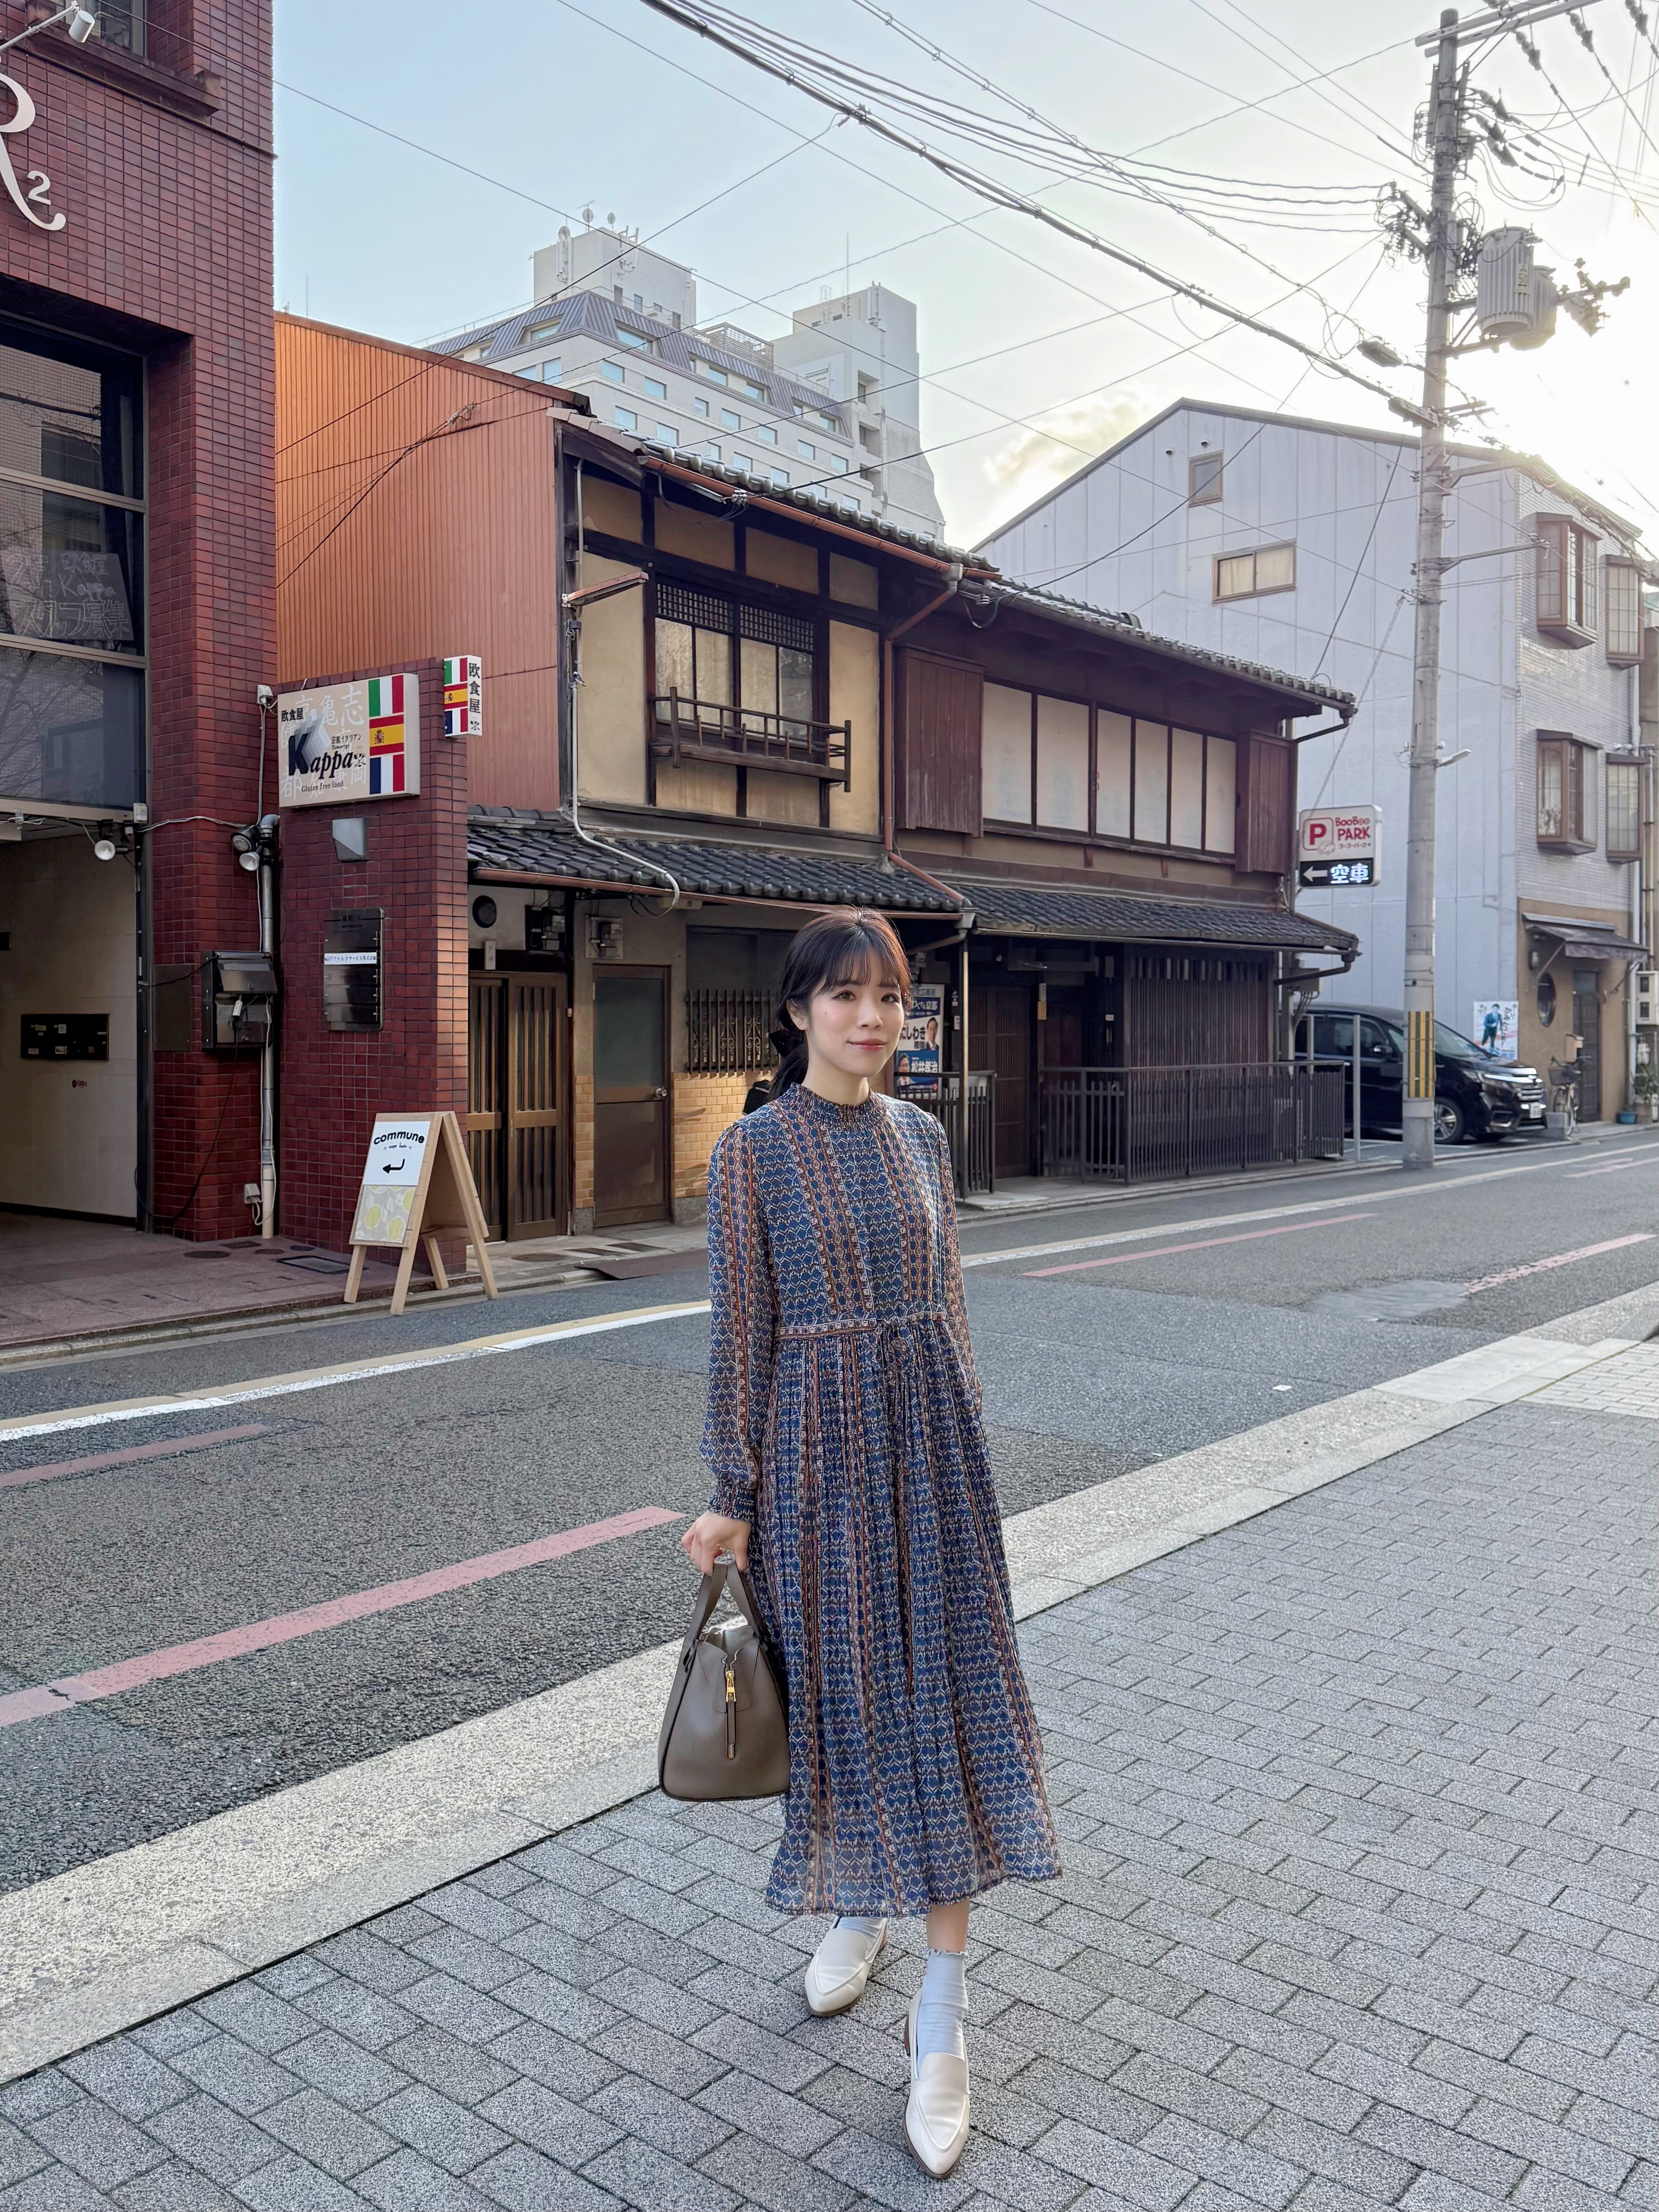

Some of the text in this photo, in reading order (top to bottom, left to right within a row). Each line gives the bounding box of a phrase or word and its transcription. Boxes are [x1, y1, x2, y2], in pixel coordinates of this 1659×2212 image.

[469, 663, 480, 714] 欧食屋
[281, 707, 304, 722] 欧食屋
[288, 732, 354, 780] Kappa
[1309, 823, 1327, 845] P
[1337, 826, 1371, 841] PARK
[1330, 863, 1369, 884] 空車
[374, 1131, 424, 1144] commune
